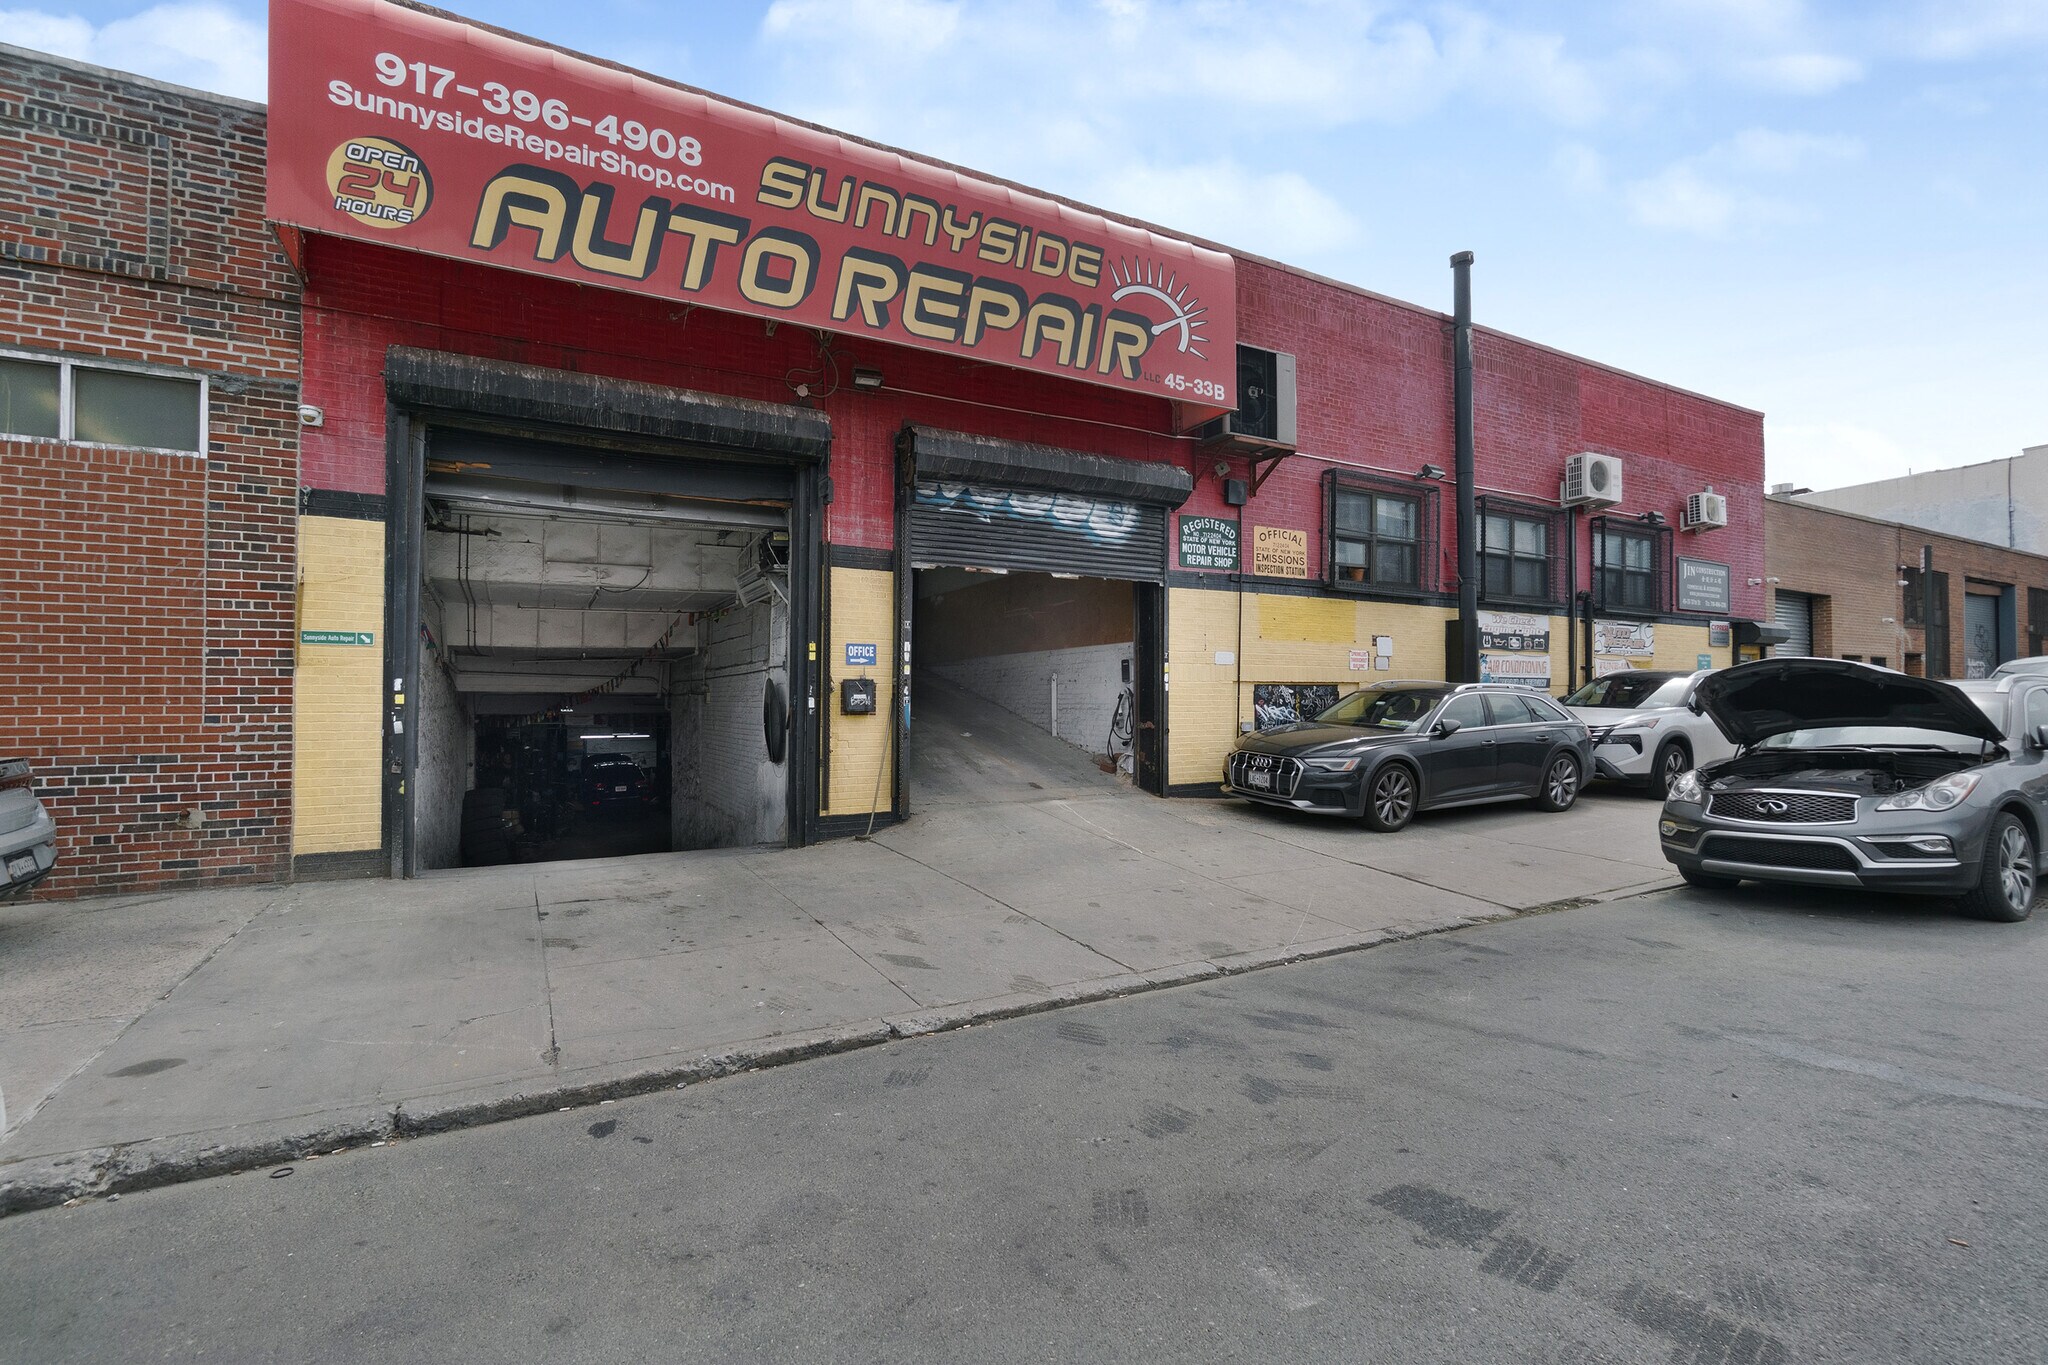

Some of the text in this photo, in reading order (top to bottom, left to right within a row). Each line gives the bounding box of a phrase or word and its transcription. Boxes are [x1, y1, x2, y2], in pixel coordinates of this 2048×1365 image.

[374, 52, 703, 167] 917-396-4908
[328, 80, 736, 204] SunnysideRepairShop.com
[345, 142, 419, 174] OPEN
[336, 165, 420, 207] 24
[334, 196, 415, 223] HOURS
[756, 156, 1104, 289] SUNNYSIDE
[470, 164, 1161, 384] AUTO REPAIR LLC
[1164, 372, 1226, 401] 45-33B
[1182, 518, 1236, 539] REGISTERED
[1259, 529, 1302, 547] OFFICIAL
[1182, 542, 1237, 557] MOTOR VEHICLE
[1186, 554, 1233, 568] REPAIR SHOP
[1256, 552, 1305, 566] EMISSIONS
[1256, 563, 1306, 577] INSPECTION STATION
[1683, 563, 1726, 580] JIN CONSTRUCTION
[1492, 614, 1537, 626] We Check
[1481, 623, 1515, 635] Engine
[1600, 625, 1631, 639] AUTO
[303, 634, 327, 642] Sunnyside
[1604, 636, 1646, 650] REPAIR
[848, 645, 874, 657] OFFICE
[1487, 659, 1547, 674] AIR CONDITIONING
